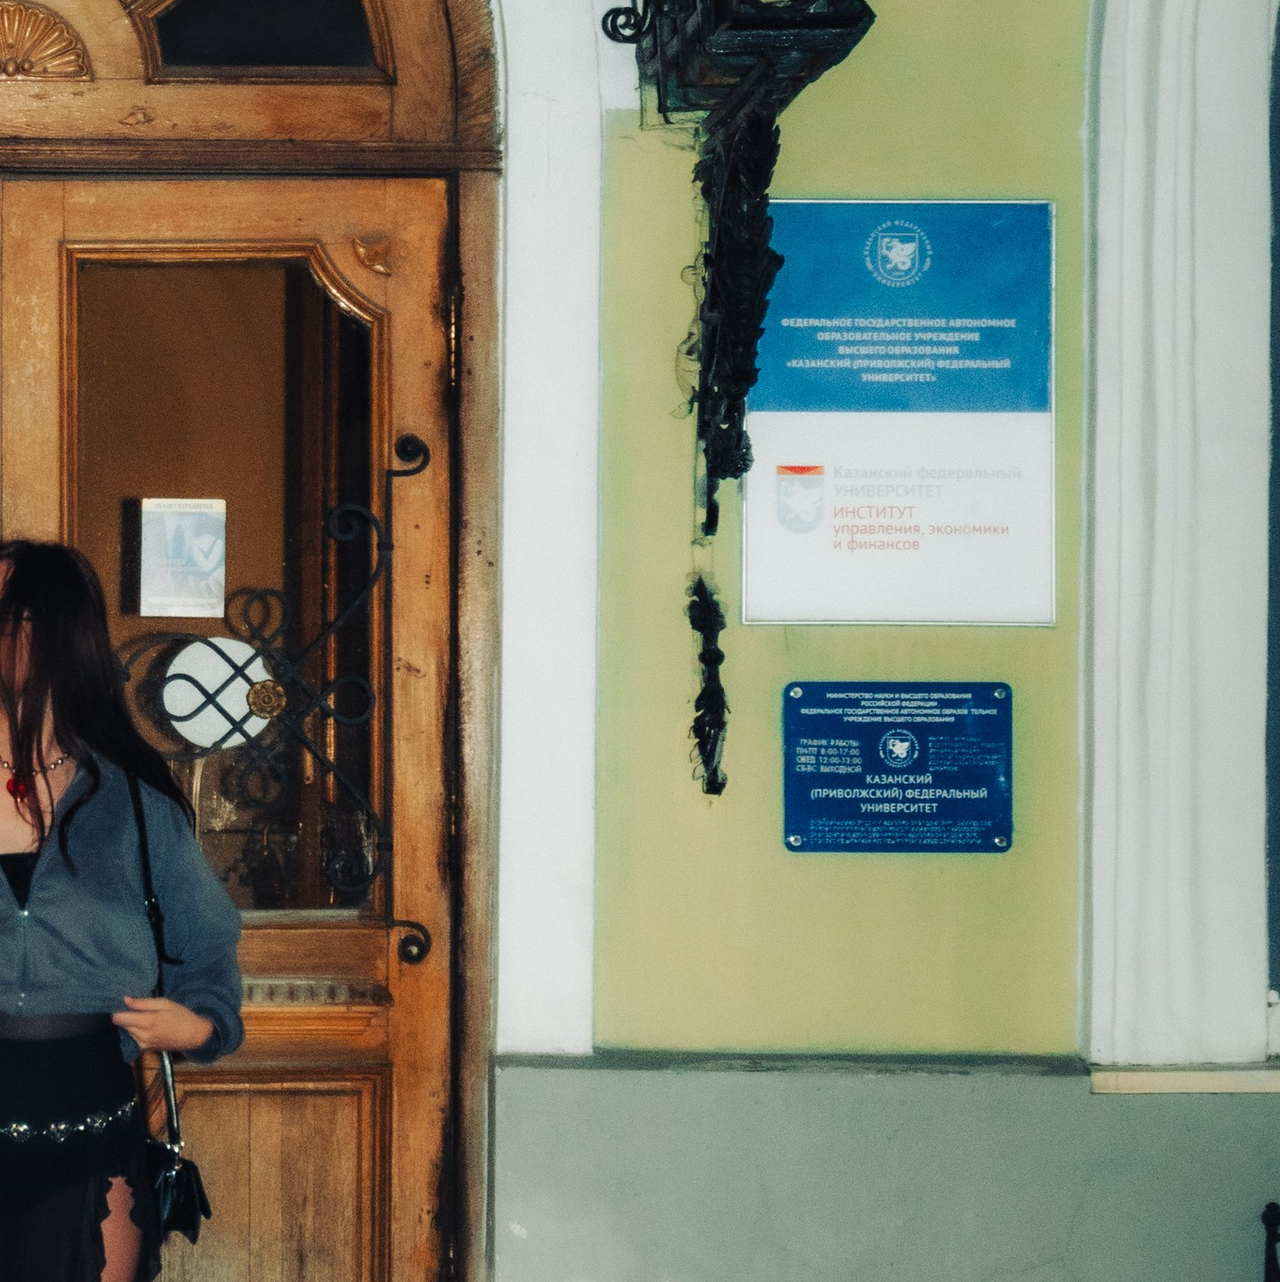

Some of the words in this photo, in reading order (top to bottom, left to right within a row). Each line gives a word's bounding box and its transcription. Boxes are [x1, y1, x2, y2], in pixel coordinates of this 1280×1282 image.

[781, 318, 853, 328] ФЕДЕРАЛЬНОЕ
[854, 318, 947, 328] ГОСУДАРСТВЕННОЕ
[949, 318, 1017, 328] АВТОНОМНОЕ
[817, 332, 912, 342] ОБРАЗОВАТЕЛЬНОЕ
[914, 332, 980, 342] УЧРЕЖДЕНИЕ
[838, 345, 886, 355] ВЫСШЕГО
[887, 345, 960, 355] ОБРАЗОВАНИЯ
[853, 358, 935, 370] (ПРИВОЛЖСКИЙ)
[936, 358, 1011, 370] ФЕДЕРАЛЬНЫЙ
[861, 372, 937, 382] УНИВЕРСИТЕТ»
[833, 465, 912, 479] Казанский
[916, 466, 1022, 481] федеральный
[834, 484, 943, 498] УНИВЕРСИТЕТ
[833, 505, 916, 519] ИНСТИТУТ
[833, 525, 924, 539] управления,
[928, 524, 1010, 535] экономики
[833, 542, 842, 550] и
[846, 538, 921, 553] финансов
[900, 692, 929, 700] ВЫСШЕГО
[865, 773, 933, 785] КАЗАНСКИЙ
[810, 788, 903, 800] (ПРИВОЛЖСКИЙ)
[905, 787, 988, 799] ФЕДЕРАЛЬНЫЙ
[860, 803, 938, 814] УНИВЕРСИТЕТ
